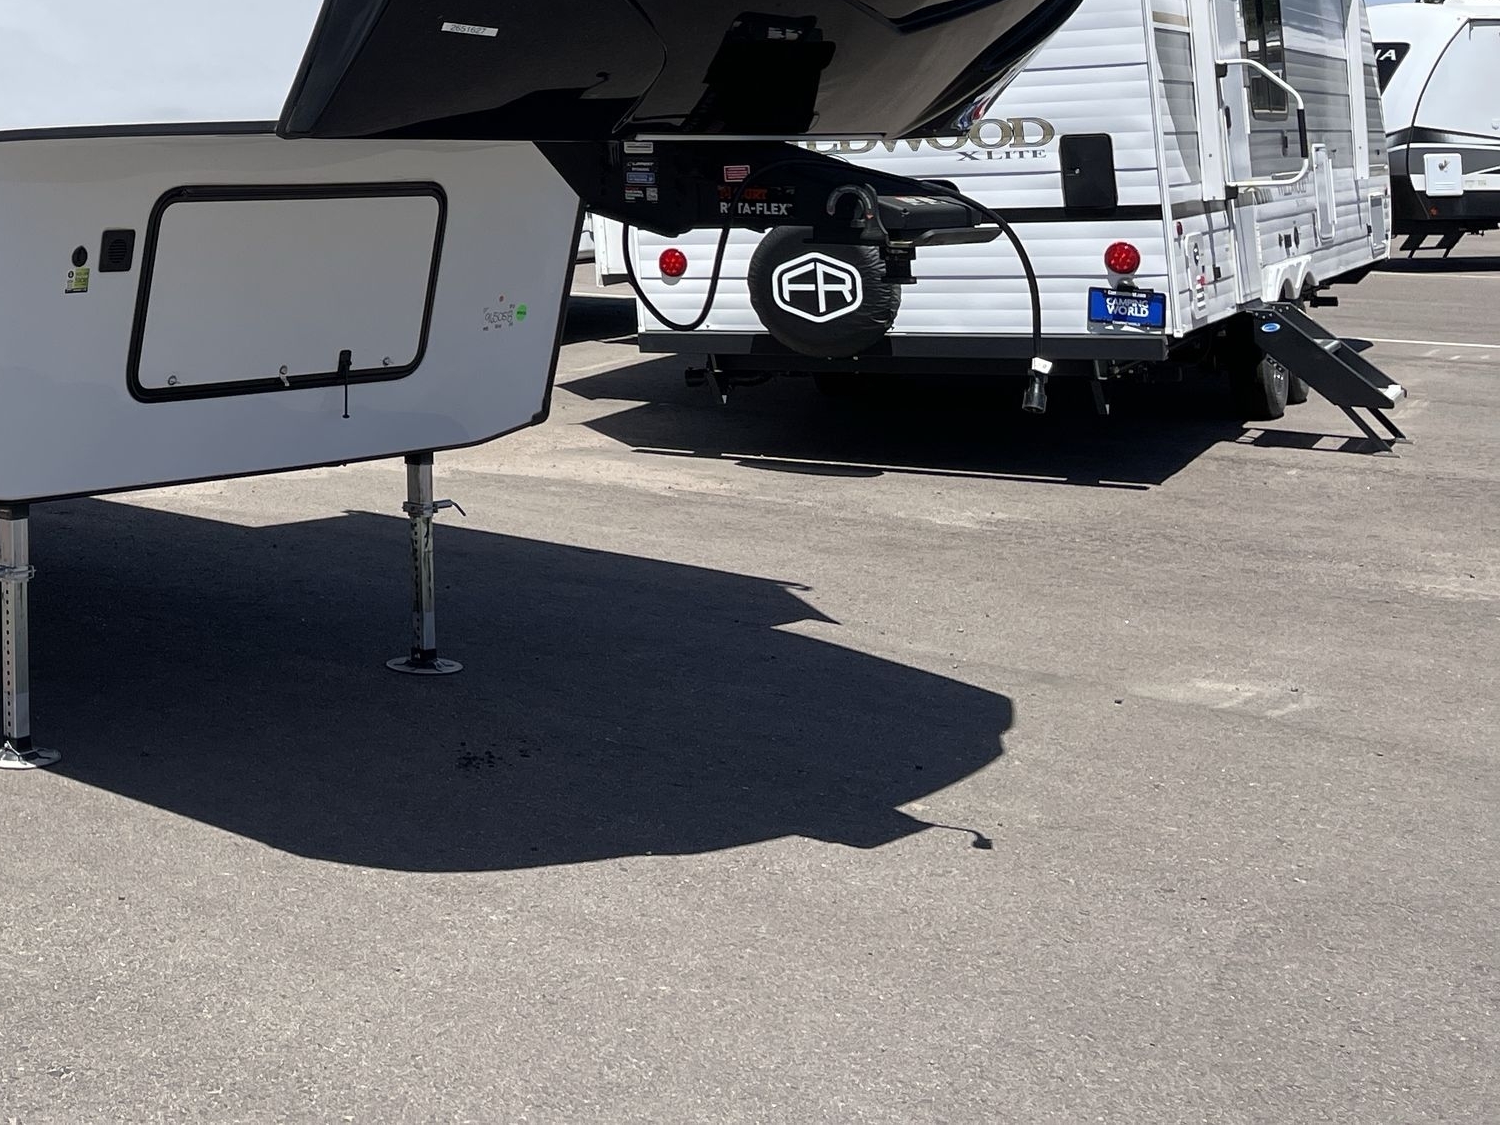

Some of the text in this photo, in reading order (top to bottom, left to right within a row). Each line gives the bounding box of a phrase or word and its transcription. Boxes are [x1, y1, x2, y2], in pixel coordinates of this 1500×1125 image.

[956, 149, 1047, 161] X LITE
[719, 201, 789, 216] RTA-FLEX
[1106, 297, 1149, 309] CAMPING
[1106, 304, 1149, 317] WORLD
